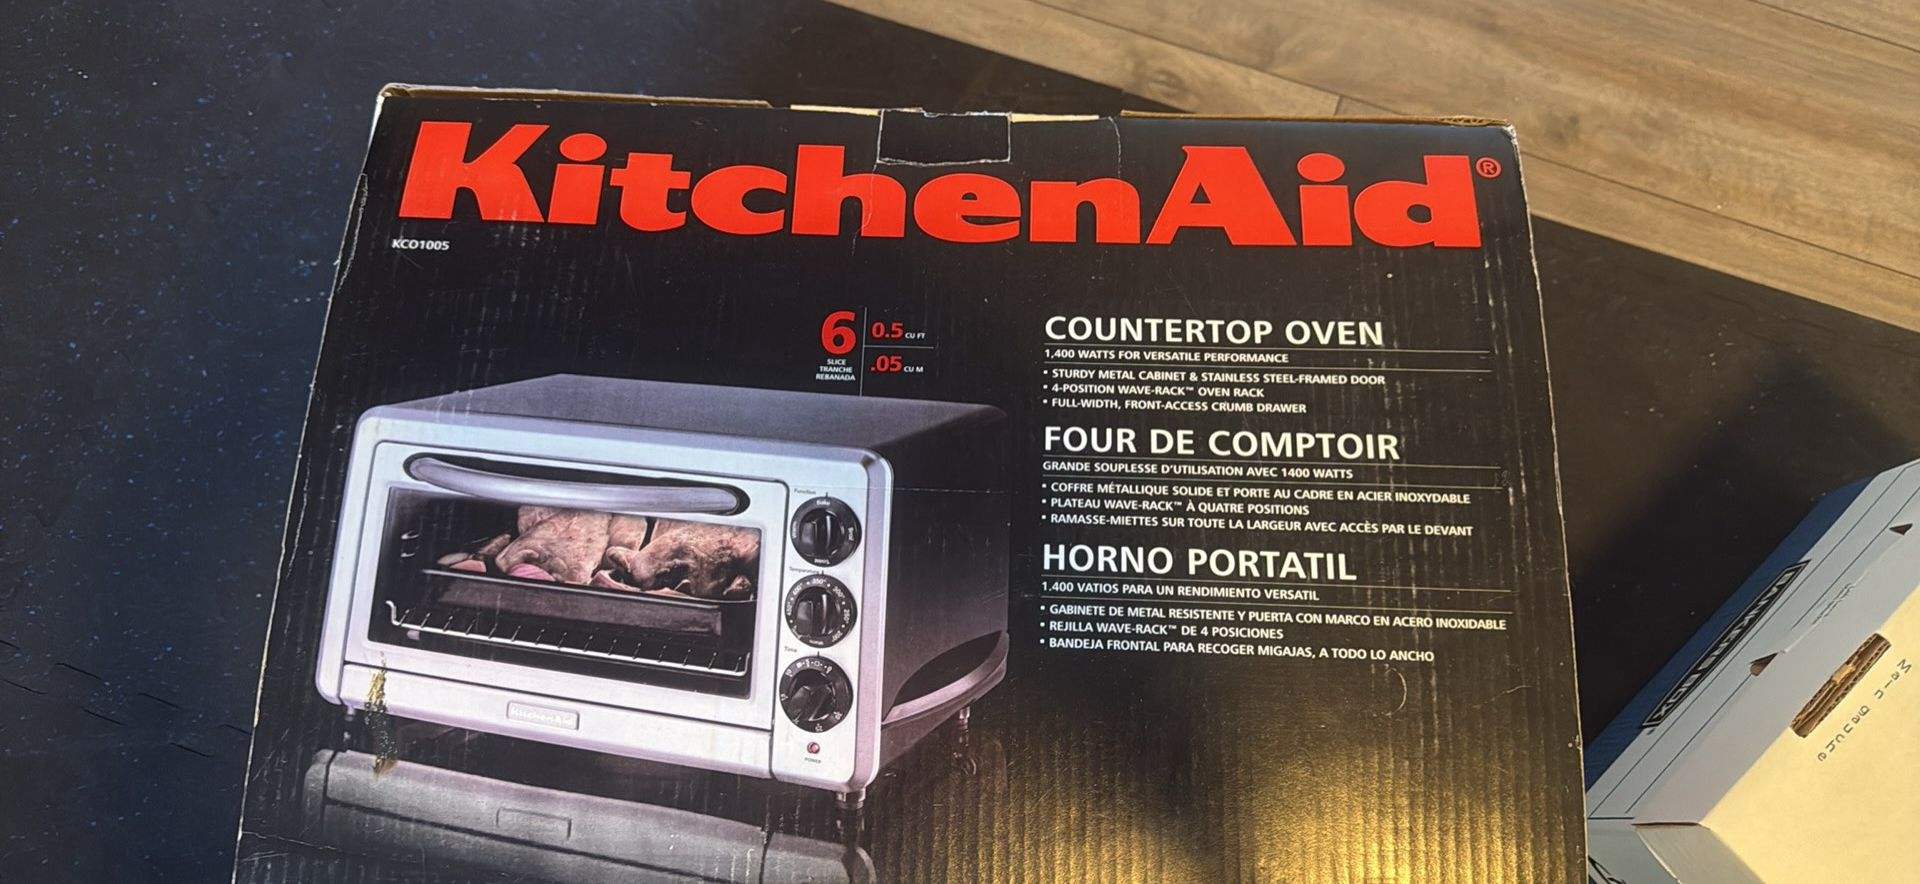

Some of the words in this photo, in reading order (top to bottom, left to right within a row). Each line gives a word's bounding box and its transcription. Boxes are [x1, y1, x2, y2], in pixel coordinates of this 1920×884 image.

[391, 239, 450, 251] KCO1005
[821, 310, 857, 355] 6
[871, 321, 904, 339] 0.5
[904, 332, 916, 340] CU
[917, 332, 926, 340] FT
[1045, 315, 1273, 344] COUNTERTOP
[1284, 319, 1383, 345] OVEN
[827, 358, 847, 366] SLICE
[870, 355, 903, 373] .05
[1044, 348, 1075, 358] 1,400
[1077, 349, 1116, 359] WATTS
[1118, 350, 1141, 359] FOR
[1142, 350, 1201, 361] VERSATILE
[1203, 352, 1289, 363] PERFORMANCE
[815, 373, 856, 381] REBANADA
[819, 365, 853, 373] TRANCHE
[1051, 368, 1096, 378] STURDY
[1098, 369, 1136, 379] METAL
[1137, 370, 1186, 381] CABINET
[1188, 371, 1198, 381] &
[1200, 371, 1260, 383] STAINLESS
[1262, 373, 1348, 384] STEEL-FRAMED
[1350, 374, 1386, 384] DOOR
[1051, 383, 1115, 393] 4-POSITION
[1197, 386, 1230, 396] OVEN
[1233, 387, 1265, 397] RACK
[1051, 397, 1121, 409] FULL-WIDTH,
[1124, 399, 1209, 411] FRONT-ACCESS
[1210, 401, 1254, 412] CRUMB
[1256, 402, 1307, 413] DRAWER
[1044, 426, 1137, 453] FOUR
[1150, 428, 1195, 454] DE
[1208, 430, 1400, 459] COMPTOIR
[1042, 460, 1090, 471] GRANDE
[1093, 462, 1158, 473] SOUPLESSE
[1245, 466, 1278, 477] AVEC
[1280, 467, 1310, 477] 1400
[1312, 468, 1354, 479] WATTS
[1050, 481, 1093, 492] COFFRE
[1096, 481, 1169, 496] MÉTALLIQUE
[1171, 485, 1213, 496] SOLIDE
[1216, 486, 1231, 497] ET
[1233, 487, 1270, 498] PORTE
[1273, 488, 1291, 499] AU
[1293, 489, 1334, 500] CADRE
[1336, 490, 1354, 500] EN
[1356, 490, 1393, 501] ACIER
[1394, 491, 1471, 504] INOXYDABLE
[1050, 497, 1101, 508] PLATEAU
[1185, 500, 1196, 511] À
[1197, 501, 1244, 513] QUATRE
[1247, 503, 1310, 515] POSITIONS
[1050, 513, 1159, 526] RAMASSE-MIETTES
[1161, 516, 1185, 527] SUR
[1187, 517, 1225, 528] TOUTE
[1228, 518, 1244, 529] LA
[1246, 519, 1302, 531] LARGEUR
[1303, 521, 1337, 532] AVEC
[1338, 521, 1379, 533] ACCÈS
[1381, 523, 1405, 533] PAR
[1407, 523, 1422, 534] LE
[1423, 524, 1473, 536] DEVANT
[1043, 543, 1173, 574] HORNO
[1188, 548, 1357, 580] PORTATIL
[1041, 581, 1074, 592] 1.400
[1076, 582, 1119, 593] VATIOS
[1122, 583, 1153, 594] PARA
[1155, 585, 1174, 595] UN
[1177, 585, 1261, 598] RENDIMIENTO
[1263, 588, 1320, 600] VERSATIL
[1049, 603, 1105, 616] GABINETE
[1108, 605, 1124, 616] DE
[1127, 606, 1166, 618] METAL
[1168, 608, 1235, 620] RESISTENTE
[1236, 610, 1246, 620] Y
[1248, 610, 1294, 622] PUERTA
[1295, 612, 1323, 623] CON
[1324, 613, 1371, 625] MARCO
[1372, 615, 1390, 626] EN
[1391, 616, 1434, 627] ACERO
[1435, 617, 1507, 630] INOXIDABLE
[1697, 570, 1797, 672] BANKERS
[1049, 620, 1094, 632] REJILLA
[1180, 625, 1197, 636] DE
[1200, 625, 1209, 636] 4
[1211, 626, 1284, 639] POSICIONES
[1049, 637, 1104, 649] BANDEJA
[1106, 639, 1160, 651] FRONTAL
[1163, 641, 1195, 652] PARA
[1197, 642, 1255, 655] RECOGER
[1257, 644, 1316, 659] MIGAJAS,
[1318, 647, 1329, 658] A
[1330, 647, 1367, 659] TODO
[1369, 648, 1387, 660] LO
[1388, 649, 1435, 661] ANCHO
[1872, 658, 1912, 699] Main
[1650, 672, 1703, 720] BOX
[1817, 705, 1871, 762] gauche
